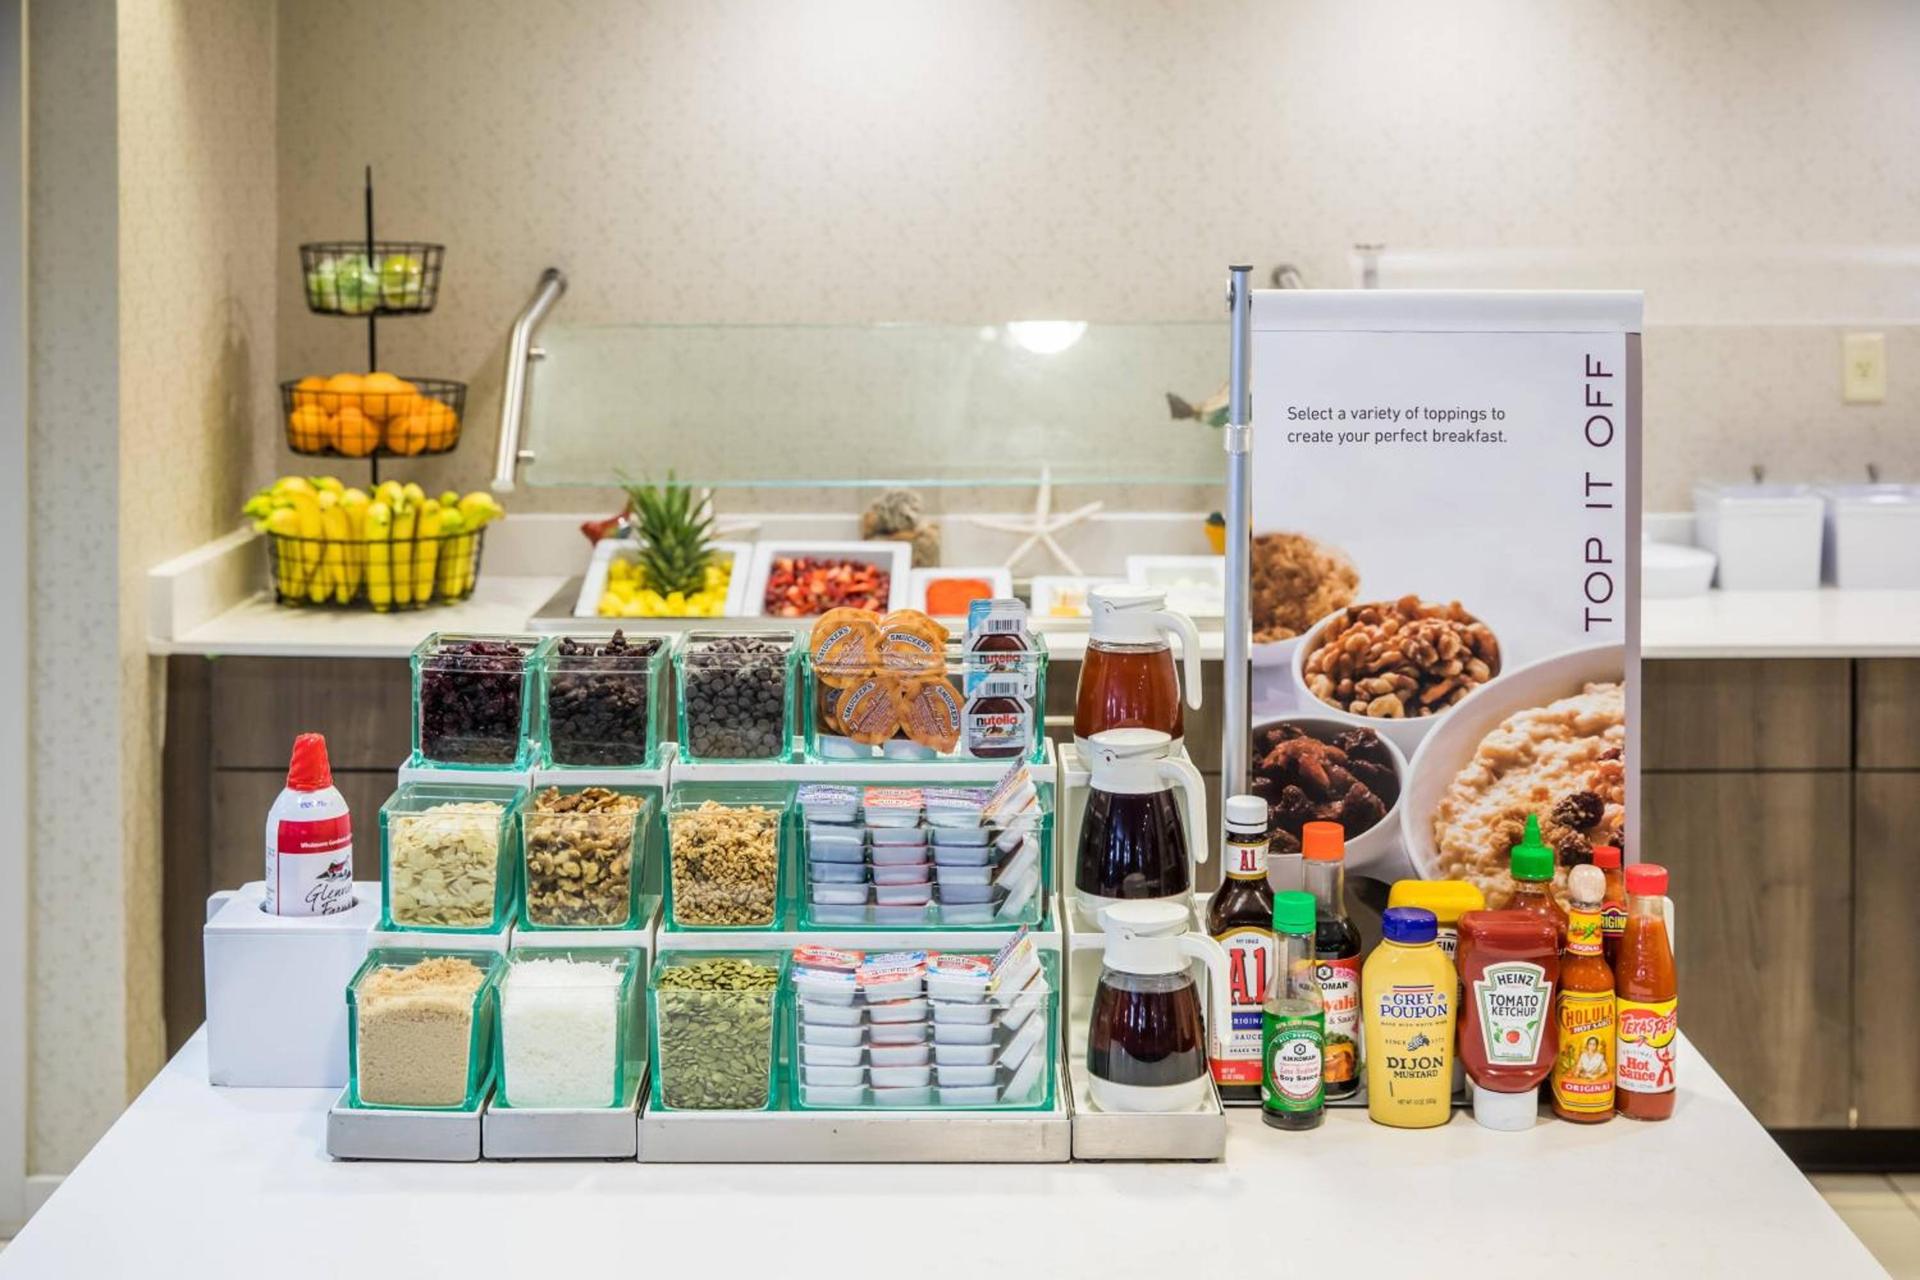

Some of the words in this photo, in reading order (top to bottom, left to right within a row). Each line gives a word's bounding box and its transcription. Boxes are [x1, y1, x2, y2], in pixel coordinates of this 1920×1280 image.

[1585, 354, 1613, 447] OFF
[1287, 407, 1333, 421] Select
[1338, 410, 1346, 420] a
[1351, 407, 1400, 423] variety
[1405, 407, 1420, 420] of
[1424, 407, 1487, 423] toppings
[1492, 408, 1505, 420] to
[1287, 430, 1334, 443] create
[1338, 432, 1370, 445] your
[1375, 428, 1427, 445] perfect
[1433, 428, 1507, 443] breakfast.
[1585, 472, 1613, 508] IT
[1585, 538, 1613, 632] TOP
[976, 714, 1018, 727] nutella
[1496, 973, 1534, 986] HEINZ
[1393, 993, 1434, 1006] GREY
[1489, 994, 1539, 1007] TOMATO
[1380, 1004, 1448, 1018] POUPON
[1491, 1007, 1537, 1017] KETCHUP
[1559, 1003, 1613, 1031] CHOLULA
[1386, 1056, 1444, 1070] DIJON
[1626, 1057, 1649, 1071] Hot
[1393, 1069, 1438, 1079] MUSTARD
[1619, 1065, 1656, 1081] Sauce
[1564, 1083, 1610, 1093] ORIGINAL
